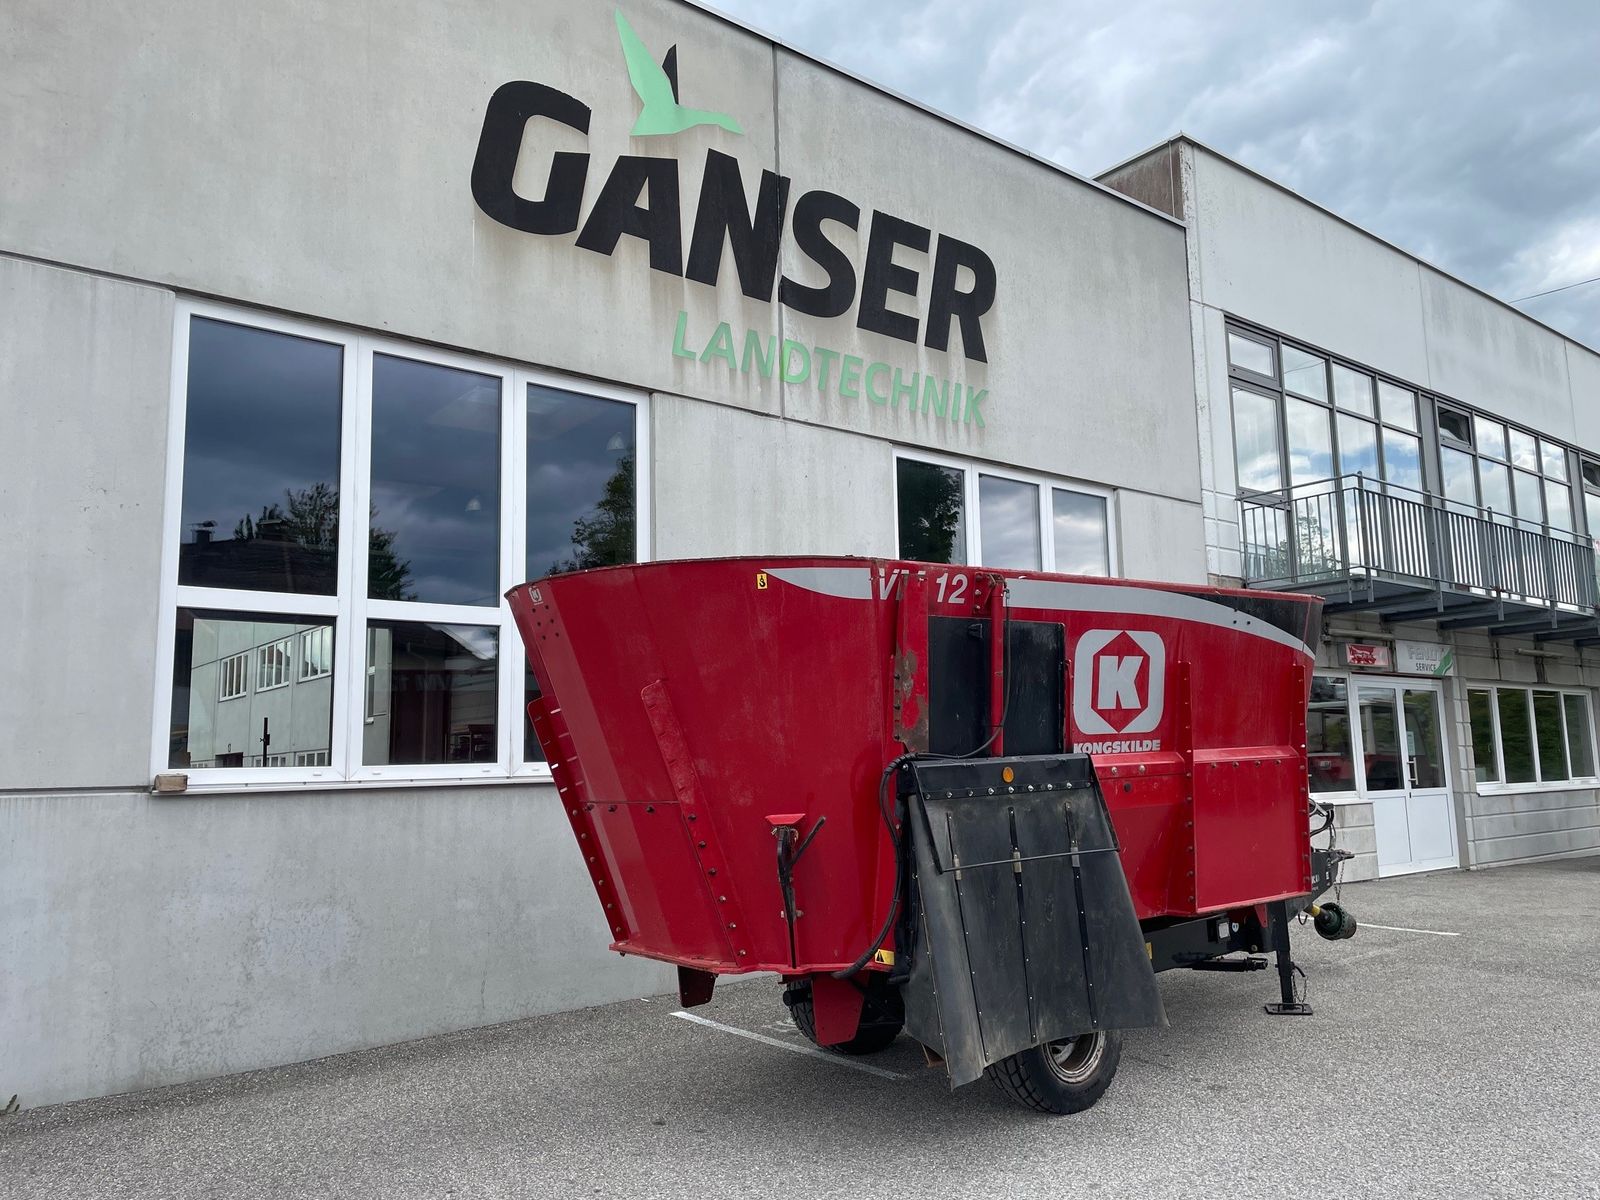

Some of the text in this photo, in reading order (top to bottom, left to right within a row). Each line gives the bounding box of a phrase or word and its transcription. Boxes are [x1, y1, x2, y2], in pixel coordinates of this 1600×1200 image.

[471, 80, 997, 363] GANSER
[672, 311, 989, 428] LANDTECHNIK
[936, 572, 968, 604] 12
[1097, 655, 1144, 710] K
[1415, 662, 1437, 672] SERVICE
[1073, 740, 1161, 755] KONGSKILDE
